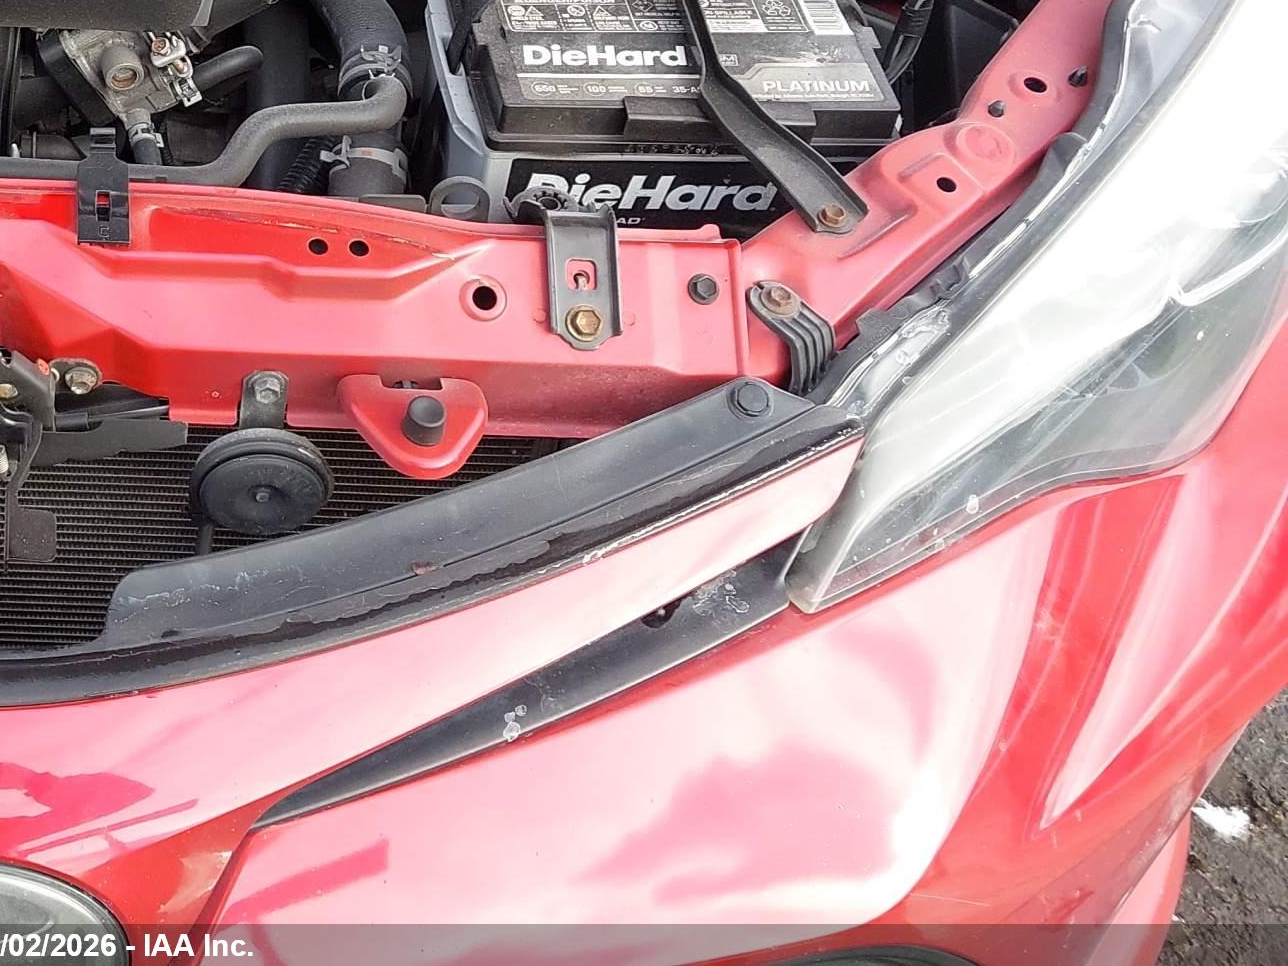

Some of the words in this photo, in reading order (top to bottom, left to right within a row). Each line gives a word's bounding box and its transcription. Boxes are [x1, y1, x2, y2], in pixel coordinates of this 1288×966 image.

[523, 44, 688, 67] DieHard
[534, 85, 556, 93] 650
[586, 85, 607, 93] 100
[672, 85, 700, 93] 35-A
[763, 80, 870, 92] PLATINUM
